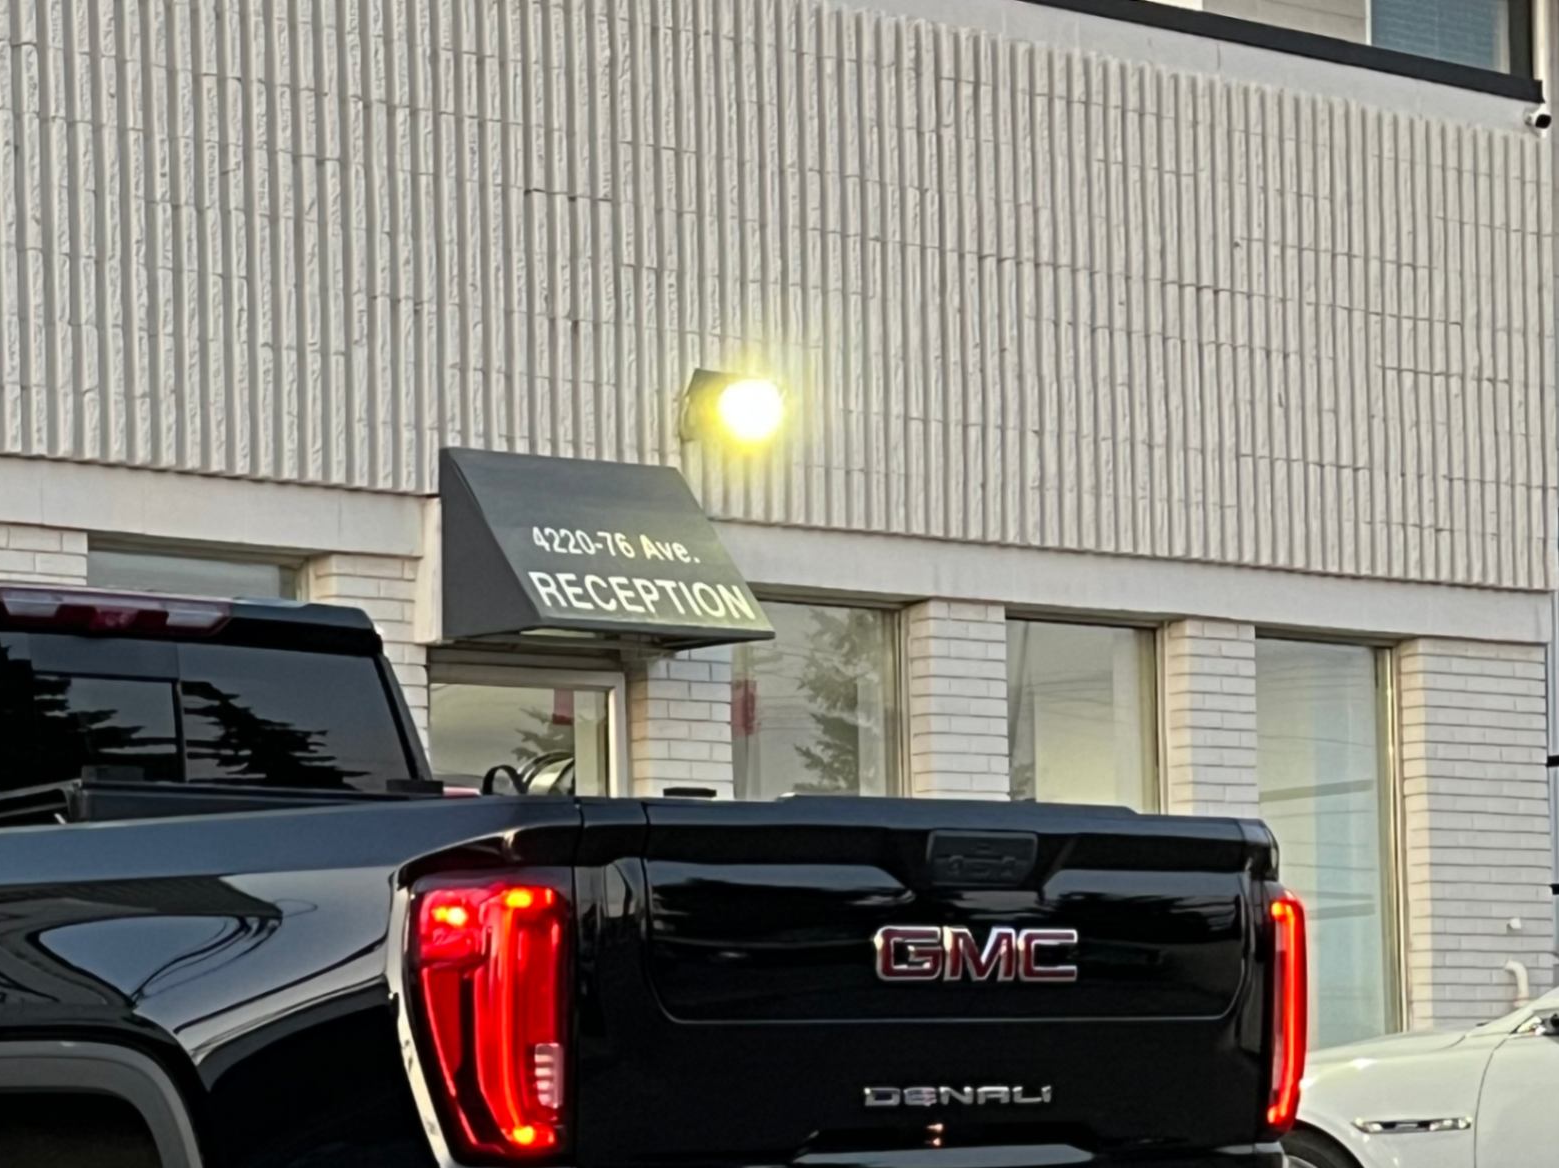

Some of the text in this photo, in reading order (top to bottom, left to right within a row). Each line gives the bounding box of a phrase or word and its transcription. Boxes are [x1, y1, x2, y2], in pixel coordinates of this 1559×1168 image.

[532, 526, 700, 564] 4220-76 Ave.
[528, 571, 756, 620] RECEPTION
[873, 925, 1078, 981] GMC
[864, 1086, 1052, 1106] DENALI
